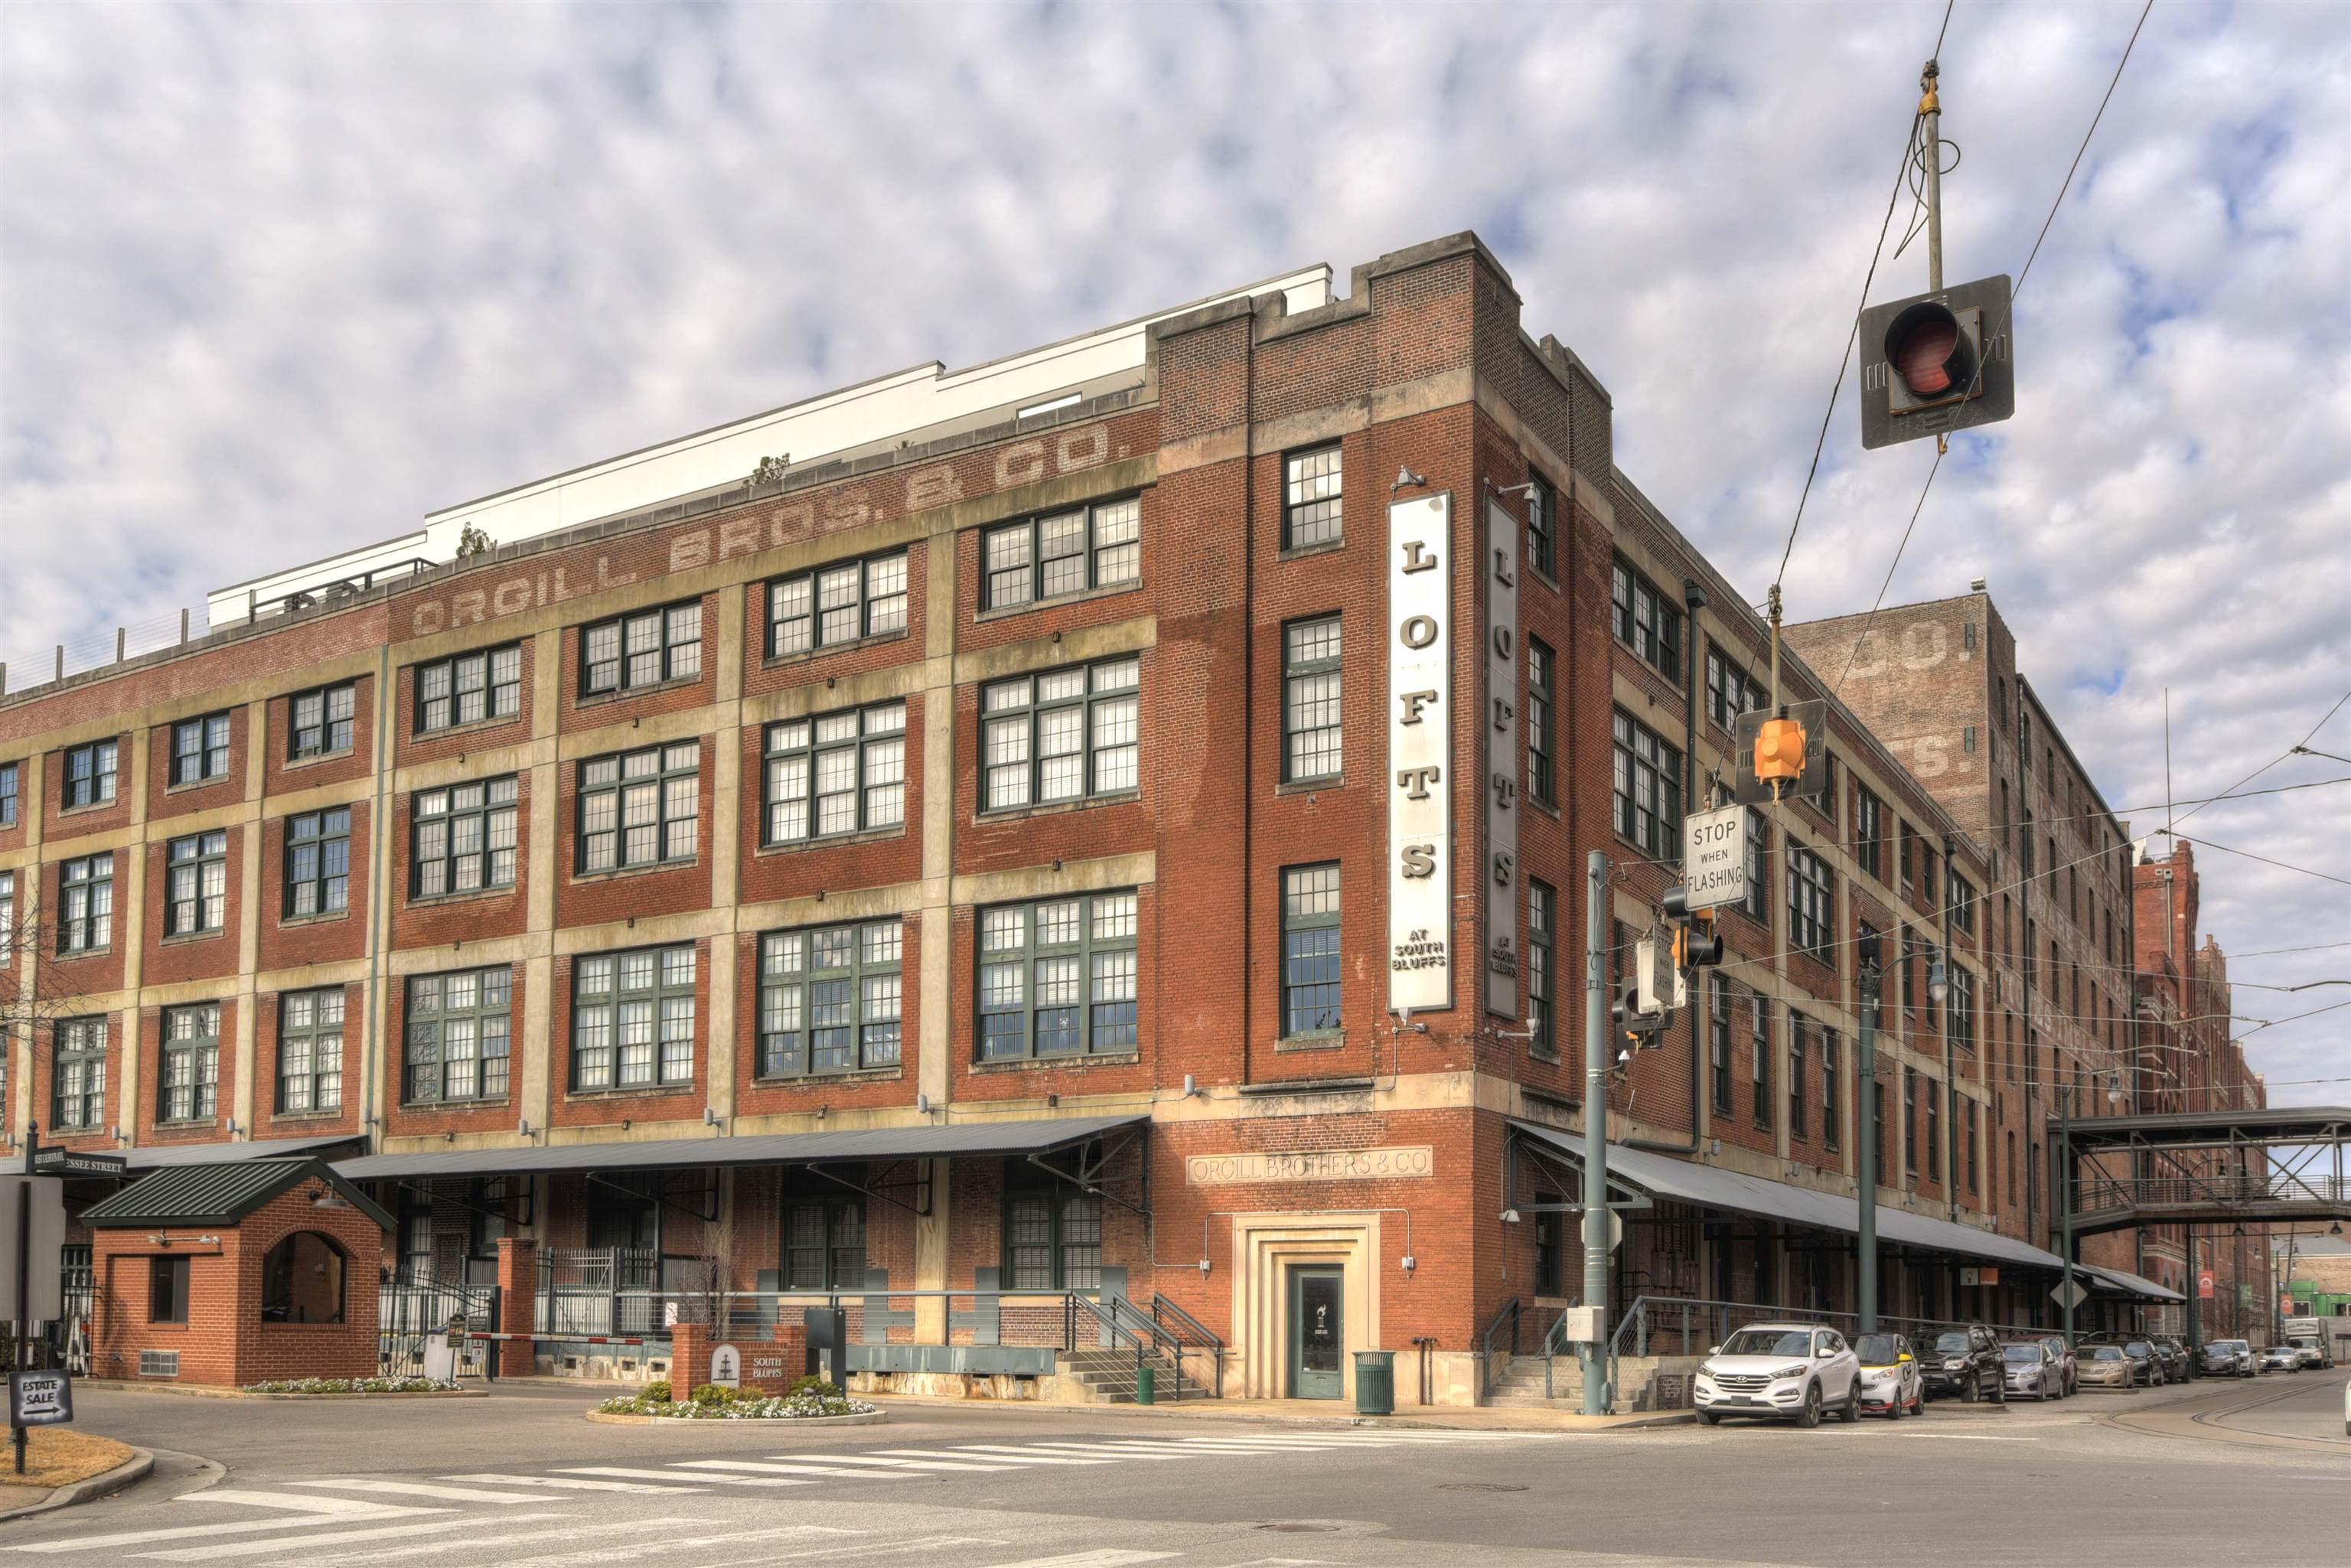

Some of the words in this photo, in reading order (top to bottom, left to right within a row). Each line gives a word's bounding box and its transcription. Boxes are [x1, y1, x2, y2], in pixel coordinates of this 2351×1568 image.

[413, 556, 637, 637] ORGILL
[906, 464, 964, 512] &
[995, 422, 1131, 489] CO.
[1397, 540, 1440, 879] LOFTS
[1494, 546, 1516, 886] LOFTS
[1694, 821, 1736, 846] STOP
[1700, 849, 1728, 864] WHEN
[1687, 865, 1743, 894] FLASHING
[1409, 928, 1430, 943] AT
[1394, 941, 1445, 957] SOUTH
[1392, 955, 1446, 972] BLUFFS
[91, 1161, 123, 1173] STREET
[1266, 1154, 1371, 1178] BROTHERS
[1378, 1152, 1390, 1173] &
[1395, 1152, 1427, 1172] CO
[753, 1358, 781, 1367] SOUTH
[752, 1368, 782, 1378] BLUFFS
[22, 1380, 57, 1392] ESTATE
[26, 1393, 55, 1405] SALE
